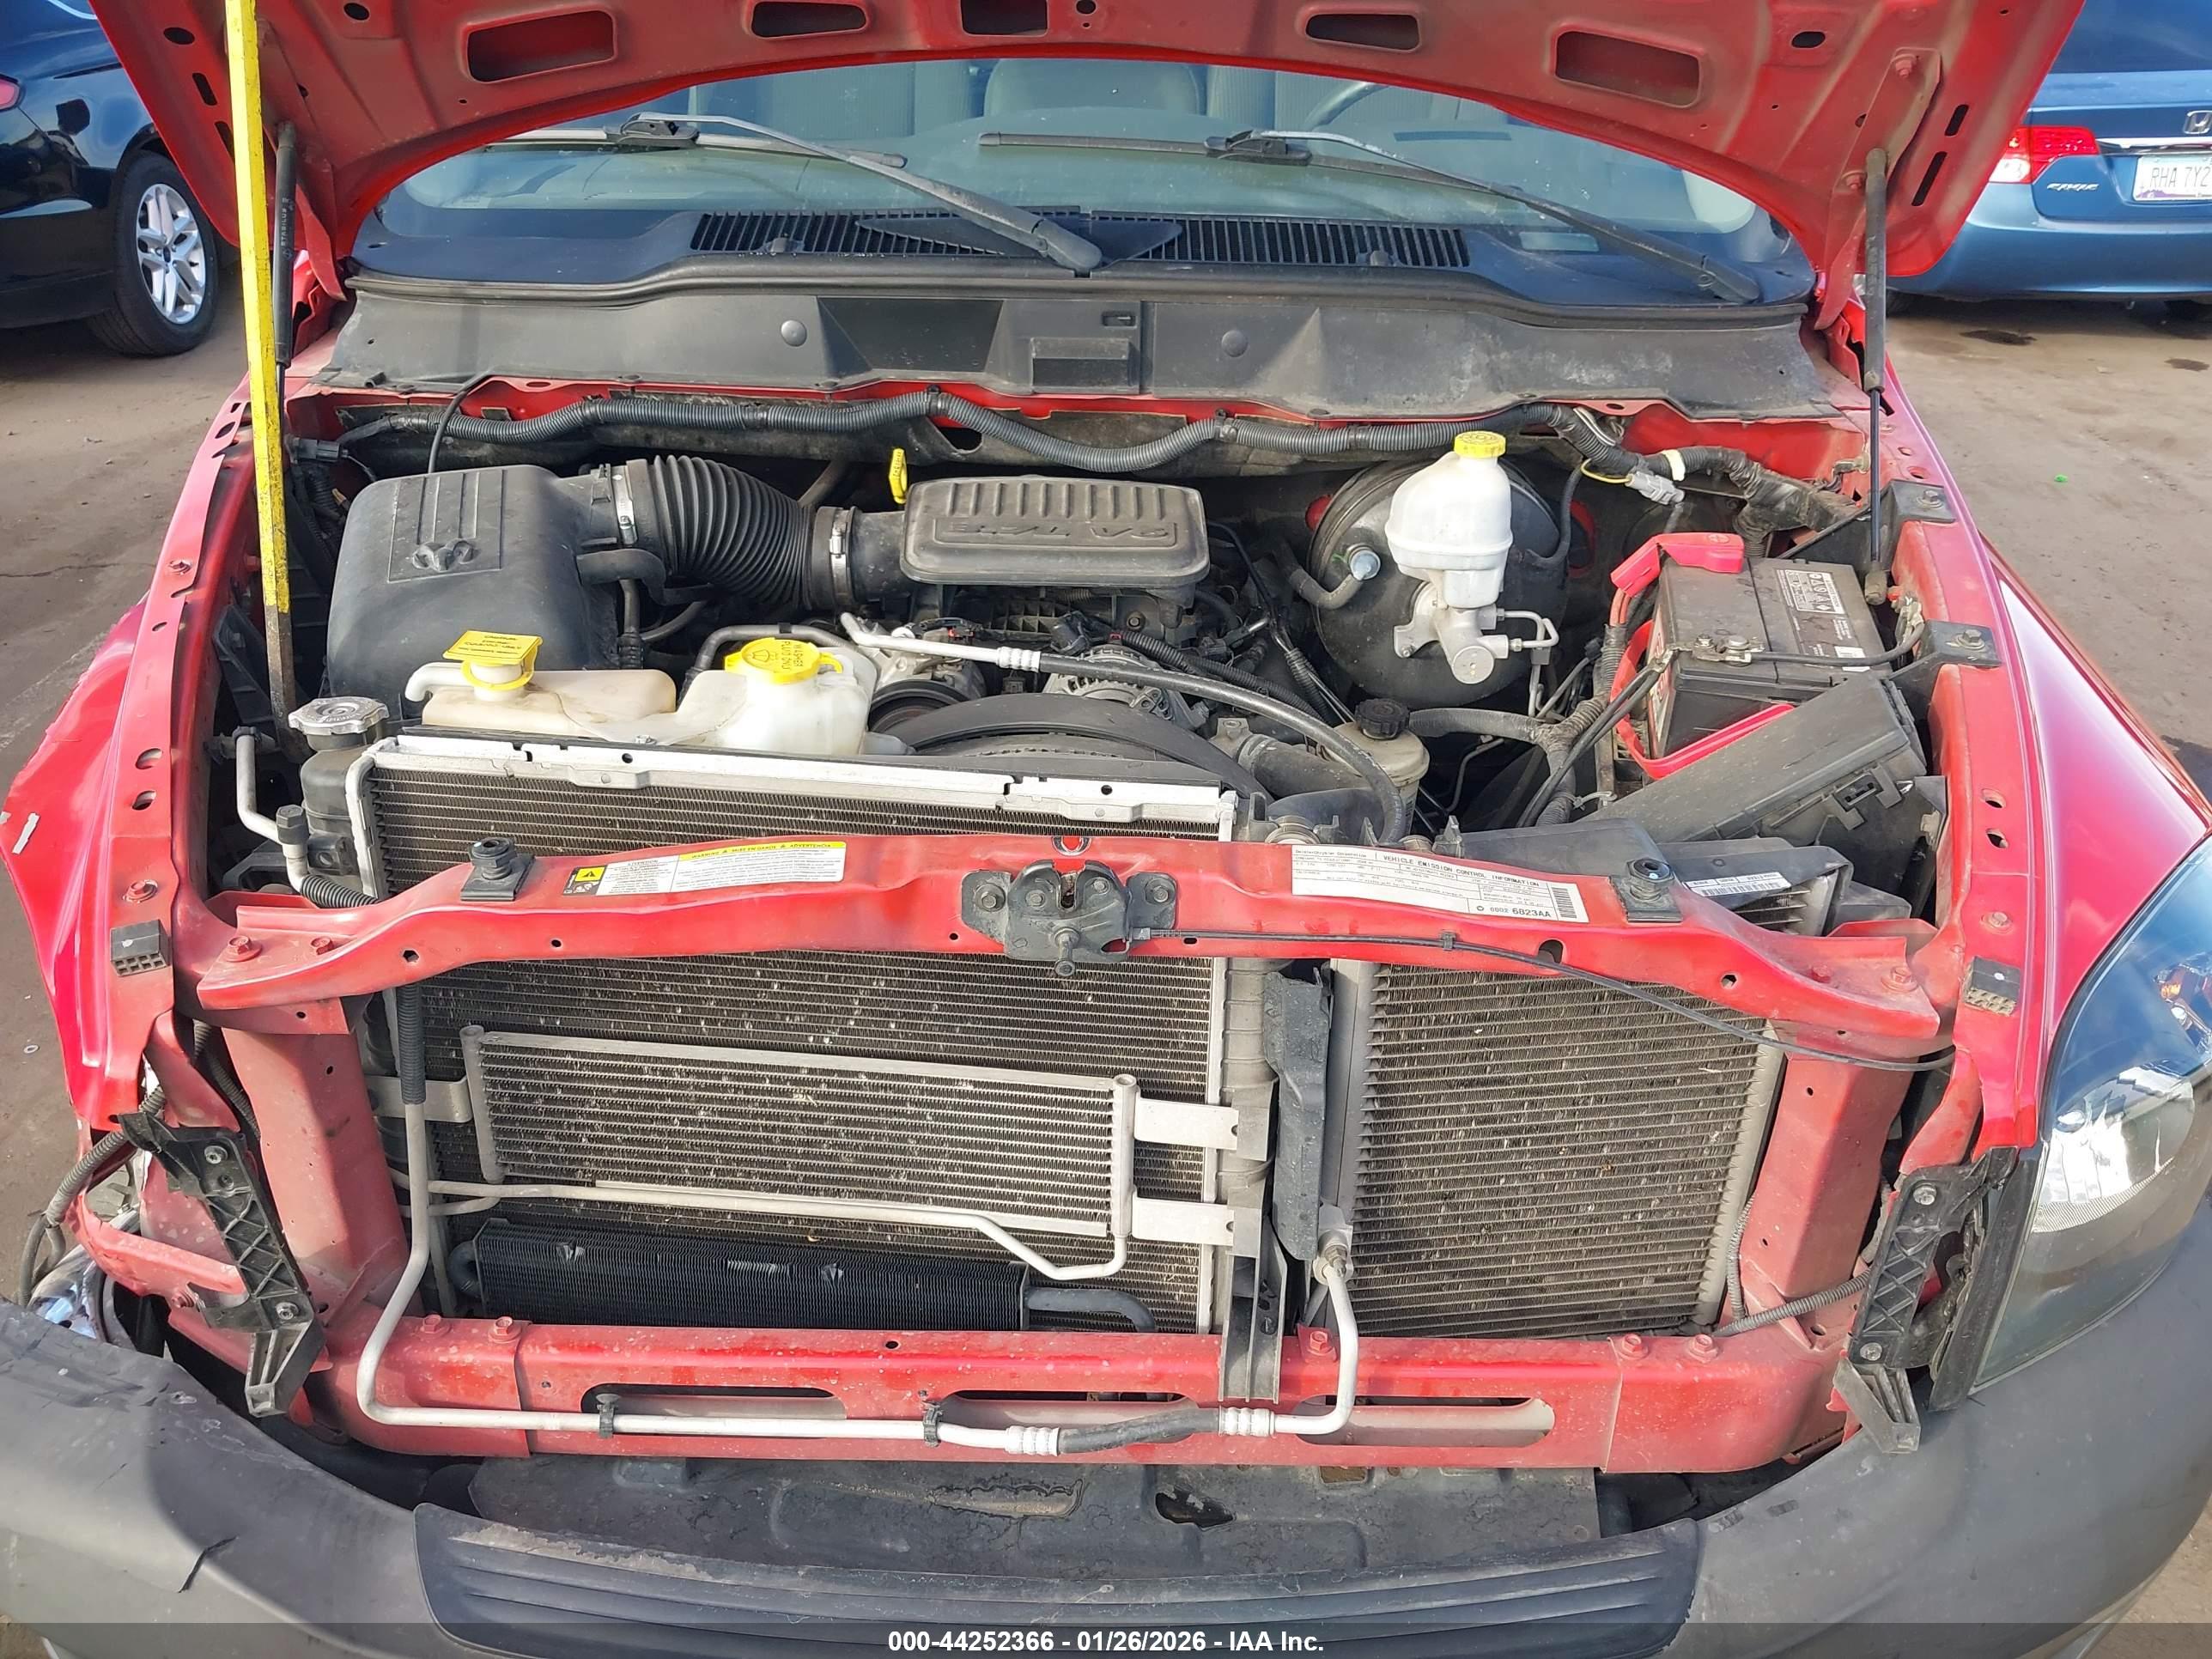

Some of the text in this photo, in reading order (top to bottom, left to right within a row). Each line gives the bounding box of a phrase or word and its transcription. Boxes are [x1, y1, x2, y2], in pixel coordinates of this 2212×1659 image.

[2149, 167, 2178, 188] RHA
[1383, 855, 1414, 865] VEHICLE
[1418, 861, 1453, 872] EMISSION
[1455, 868, 1486, 878] CONTROL
[1492, 875, 1540, 887] INFORMATION
